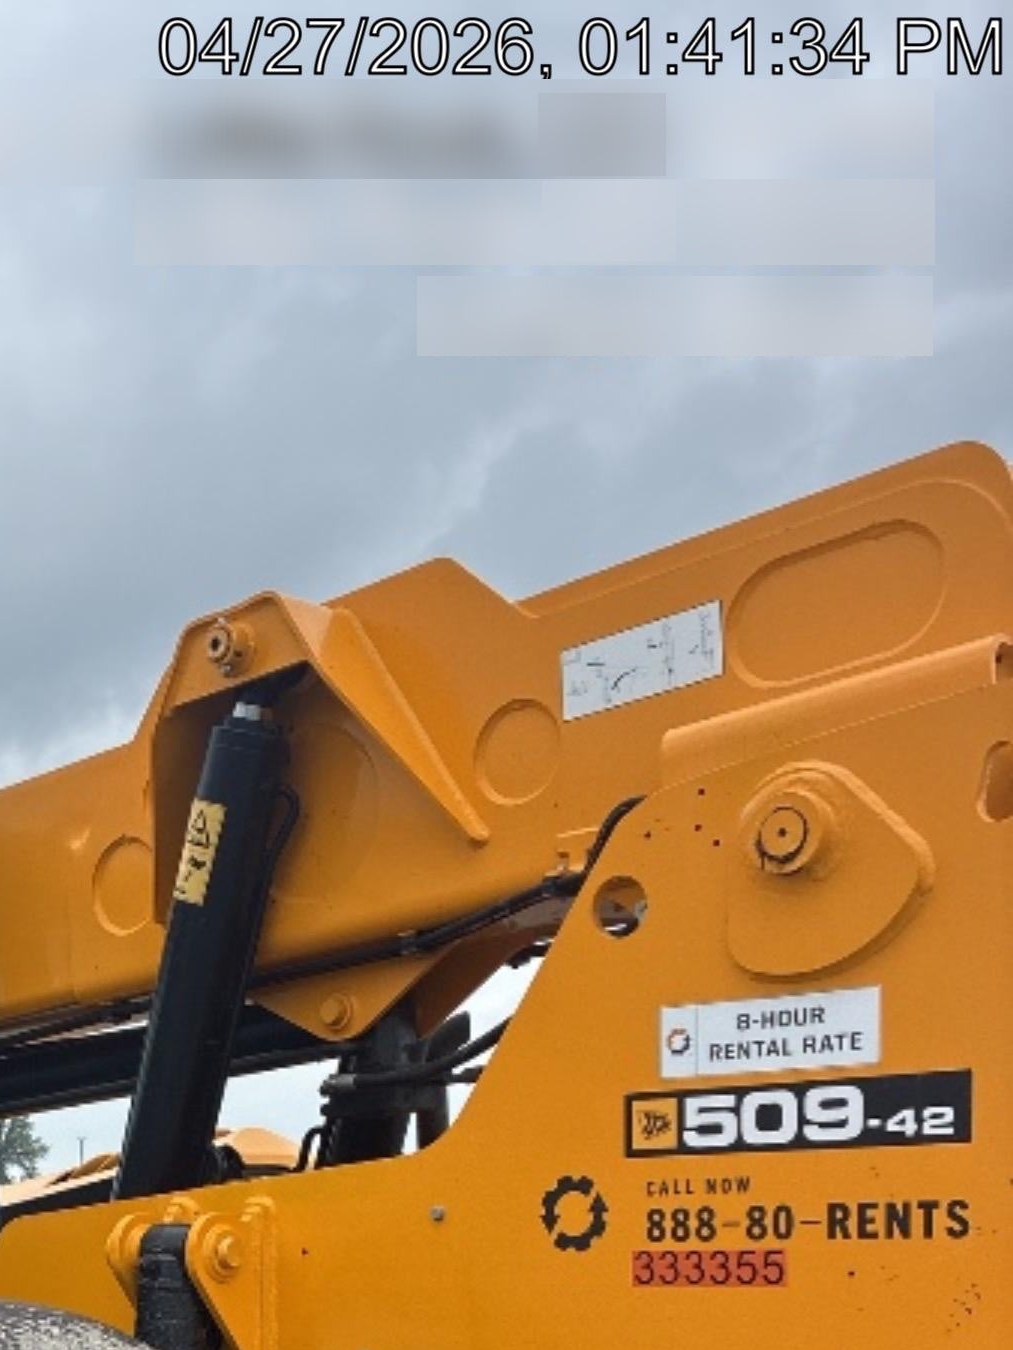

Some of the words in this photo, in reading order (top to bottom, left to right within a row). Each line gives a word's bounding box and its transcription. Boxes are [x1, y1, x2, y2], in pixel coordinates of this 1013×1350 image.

[736, 1006, 826, 1031] 8-HOUR
[708, 1035, 792, 1062] RENTAL
[802, 1031, 863, 1054] RATE
[682, 1085, 956, 1147] 509-42
[646, 1180, 694, 1196] CALL
[705, 1176, 751, 1193] NOW
[645, 1200, 971, 1243] 888-80-RENTS
[634, 1250, 785, 1285] 333355
